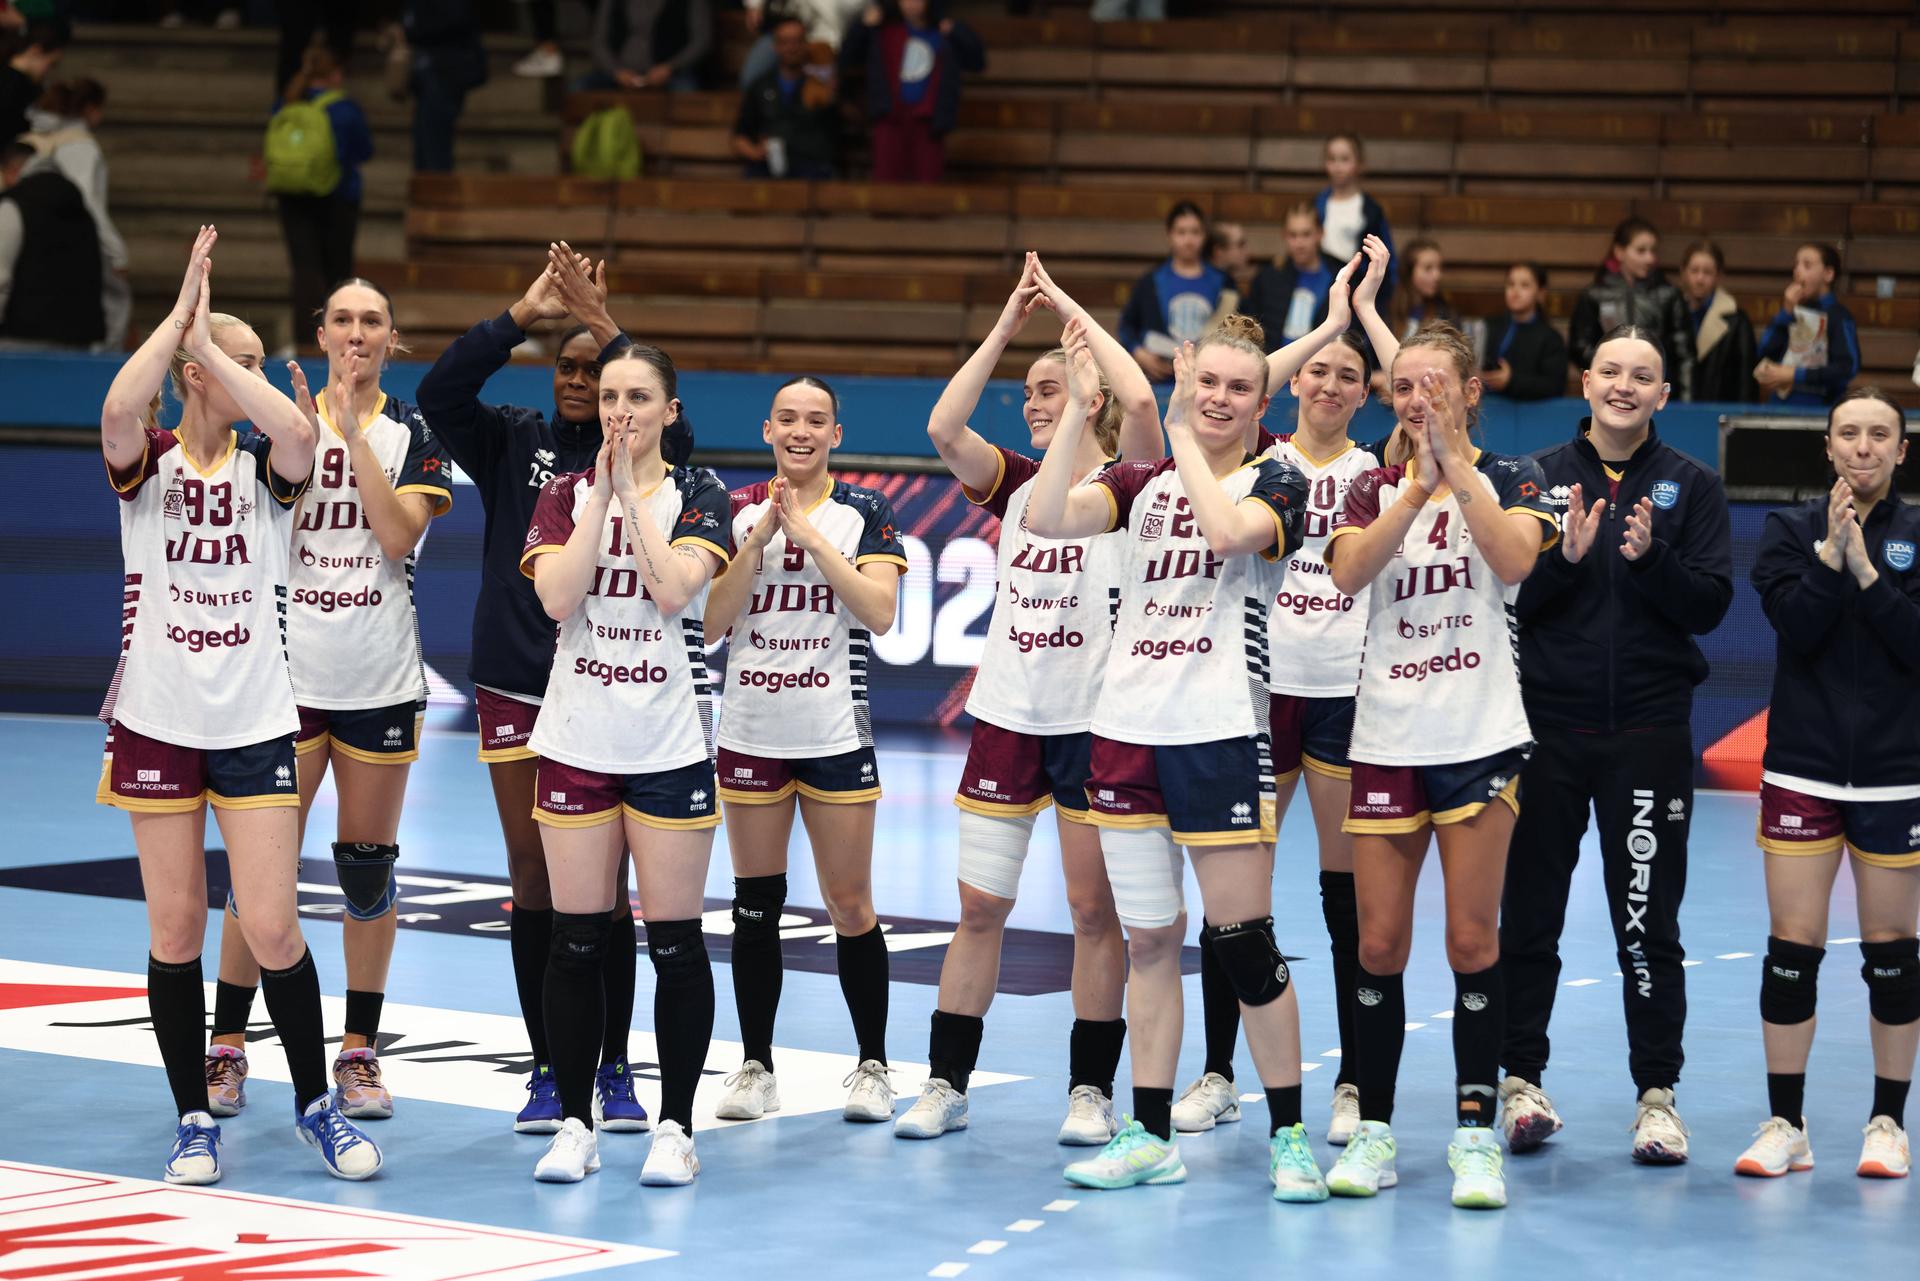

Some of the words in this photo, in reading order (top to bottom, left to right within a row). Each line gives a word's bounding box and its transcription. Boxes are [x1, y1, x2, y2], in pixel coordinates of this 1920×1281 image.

[321, 448, 358, 489] 9
[184, 479, 232, 527] 93
[1152, 502, 1168, 512] erre
[1170, 497, 1203, 538] 2
[1427, 511, 1450, 551] 4
[166, 531, 252, 566] JDA
[608, 516, 634, 558] 1
[1393, 556, 1476, 602] JDA
[183, 589, 253, 607] SUNTEC
[292, 586, 382, 613] sogedo
[748, 584, 836, 615] JDA
[1021, 595, 1078, 610] SUNTEC
[1157, 600, 1213, 618] SUNT
[1276, 592, 1354, 616] ogedo
[596, 625, 663, 642] SUNTEC
[769, 636, 831, 651] SUNTEC
[574, 657, 668, 687] sogedo
[1388, 647, 1481, 682] sogedo
[739, 666, 830, 694] sogedo
[1231, 816, 1253, 825] errea
[1625, 789, 1658, 935] INORIX
[738, 906, 764, 918] SELECT
[1772, 965, 1800, 979] SELECT
[1873, 967, 1901, 978] SELECT
